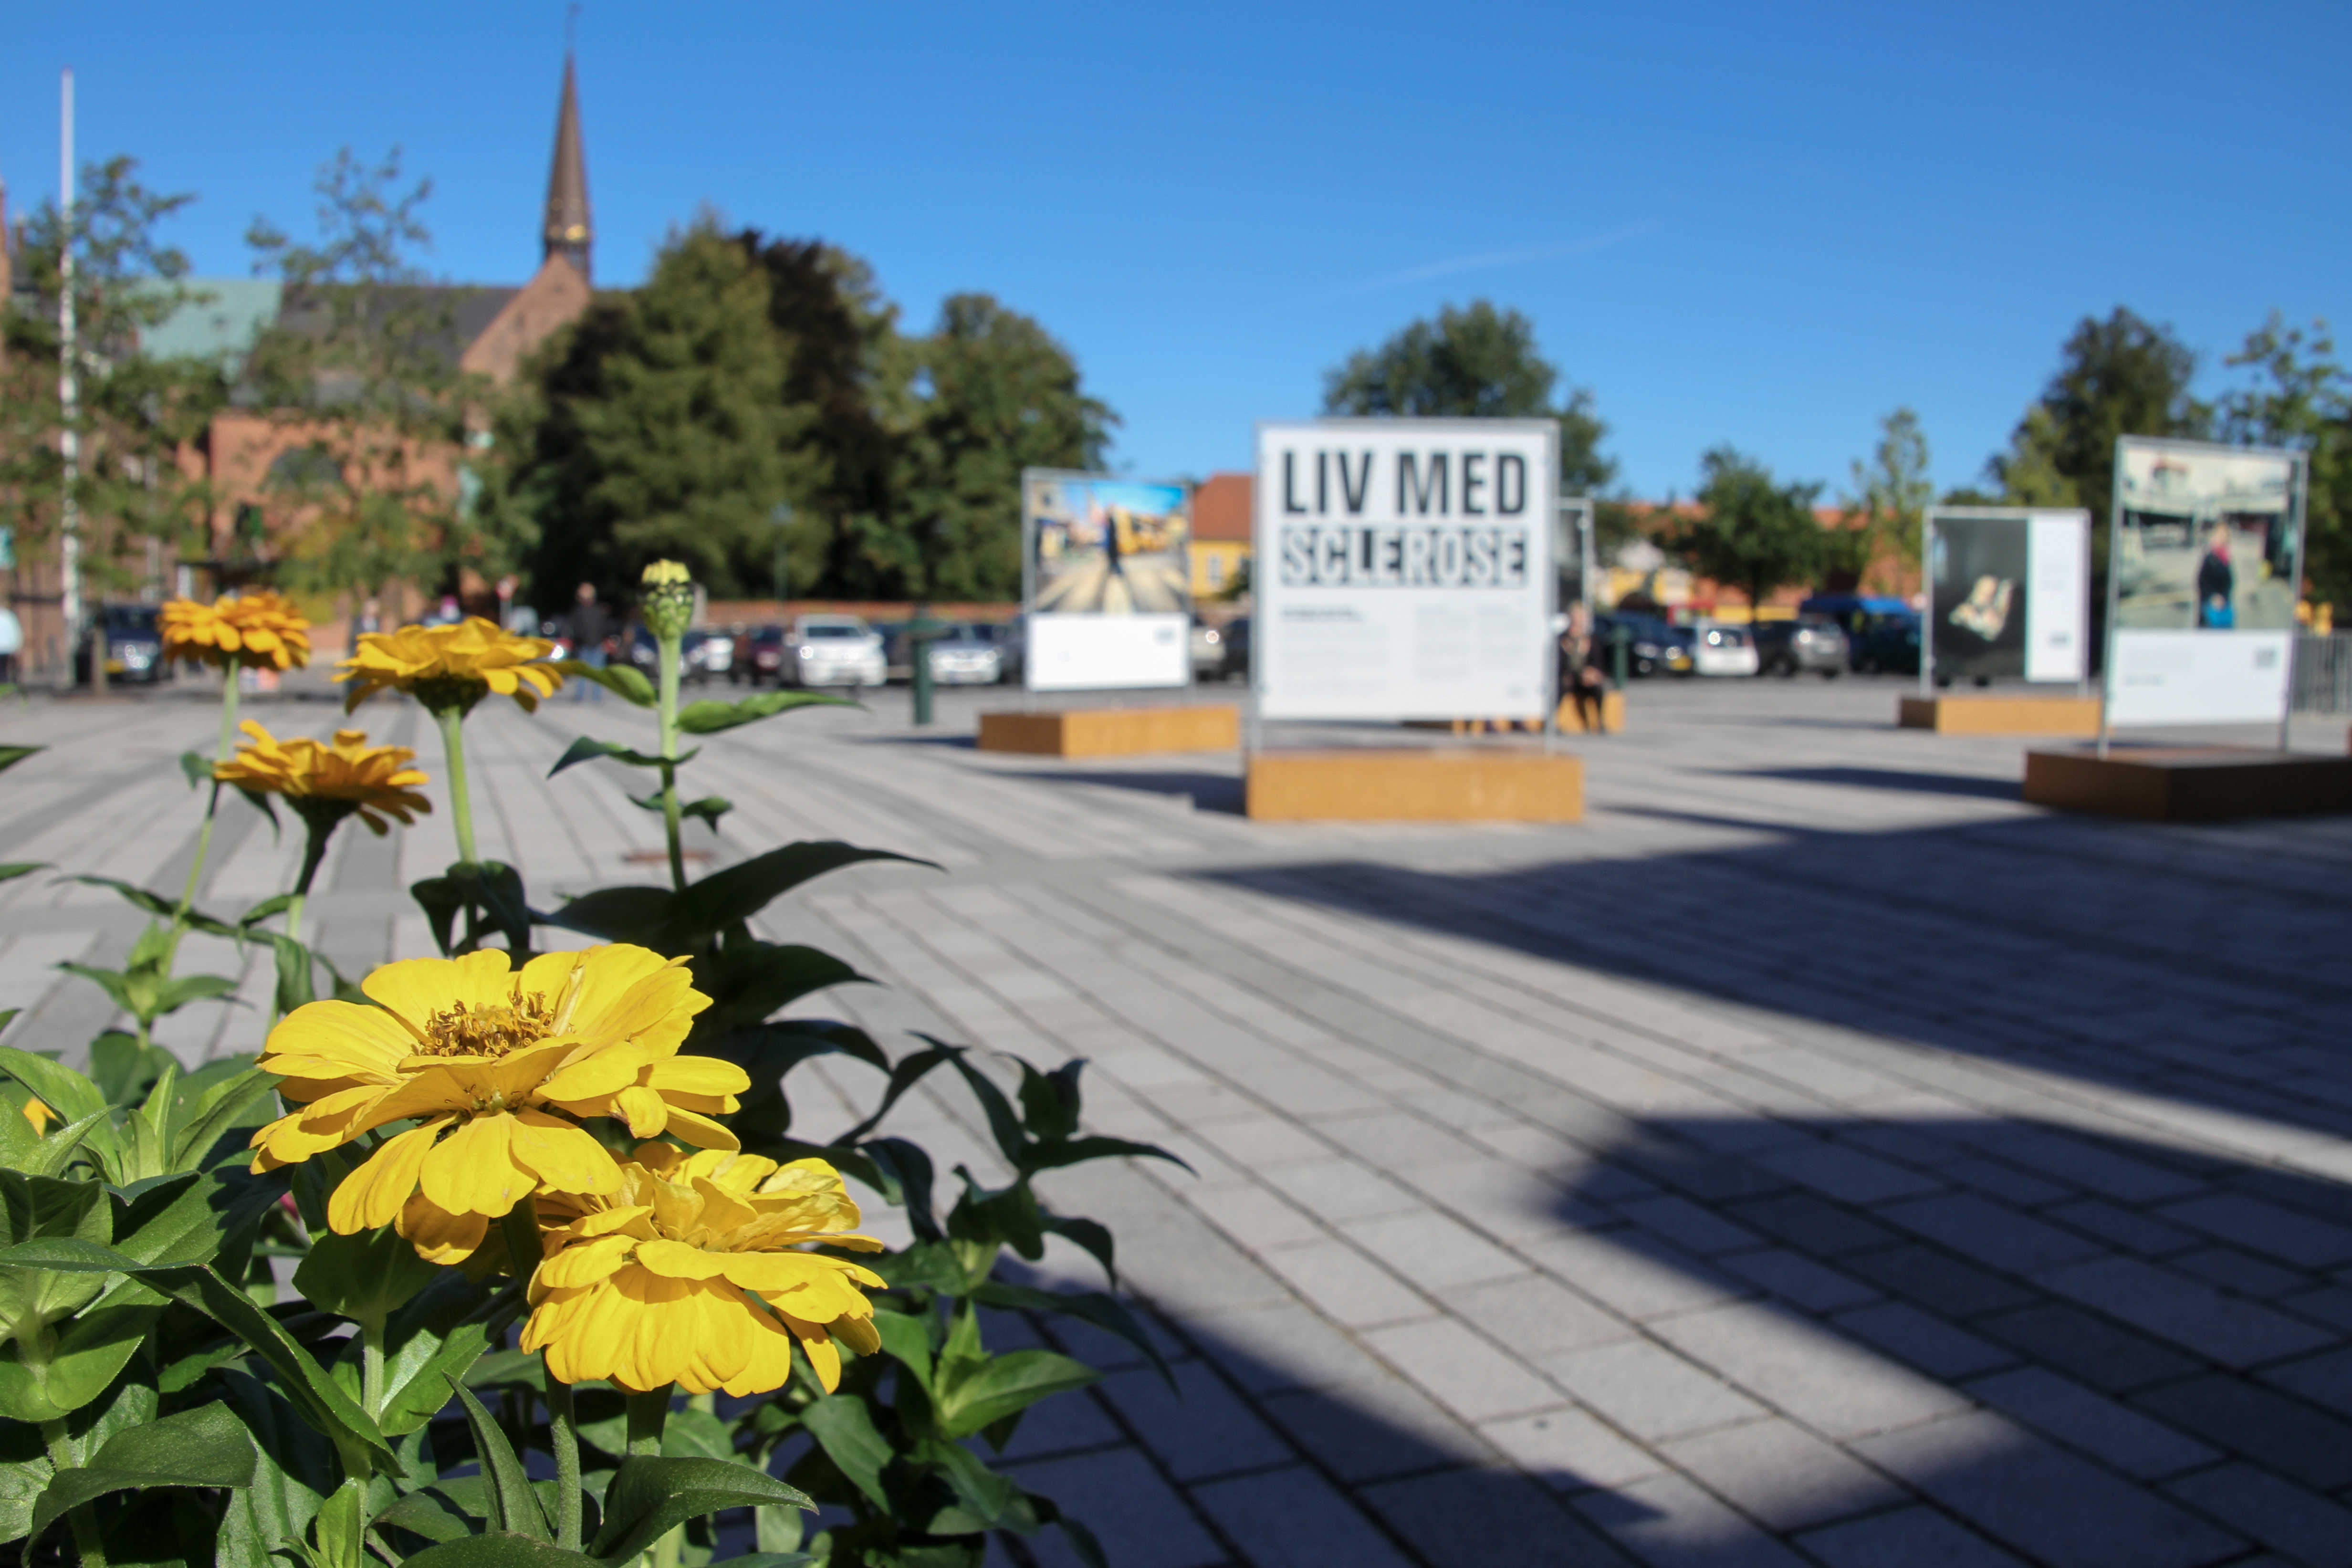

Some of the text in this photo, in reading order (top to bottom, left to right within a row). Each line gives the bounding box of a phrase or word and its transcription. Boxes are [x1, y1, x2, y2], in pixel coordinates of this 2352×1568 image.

[1283, 450, 1526, 515] LIV MED
[1283, 528, 1526, 585] SCLEROSE
